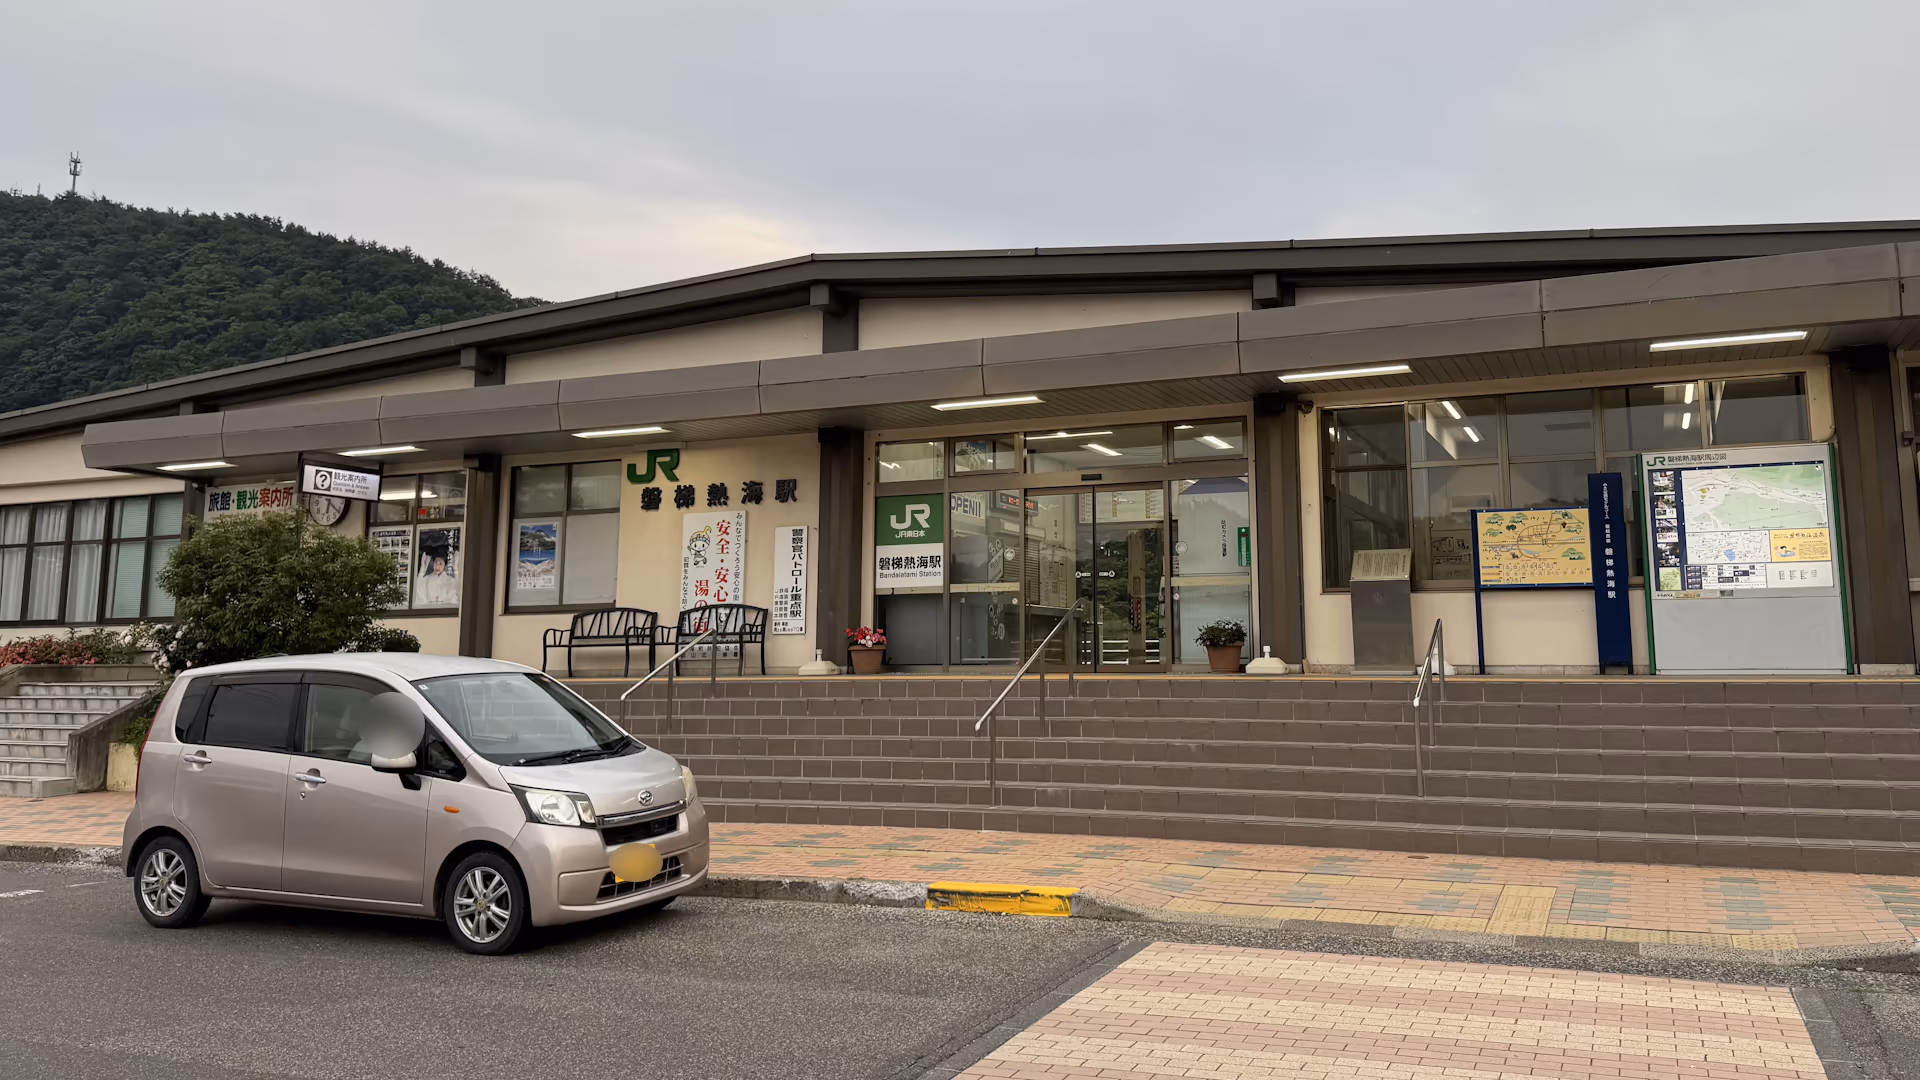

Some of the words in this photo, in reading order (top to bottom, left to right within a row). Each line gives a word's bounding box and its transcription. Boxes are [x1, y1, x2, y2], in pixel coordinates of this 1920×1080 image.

[627, 449, 680, 484] JR
[1646, 456, 1666, 467] JR
[333, 471, 368, 484] 観光案内所
[640, 479, 798, 512] 磐梯熱海駅
[890, 503, 931, 530] JR
[895, 530, 926, 539] JR東日本
[713, 519, 731, 603] 安全・安心
[789, 528, 804, 618] 警察官パトロール重点駅
[879, 555, 942, 571] 磐梯熱海駅
[879, 571, 918, 579] Bandaiatami
[918, 570, 942, 578] Station
[1604, 547, 1616, 599] 磐梯熱海駅
